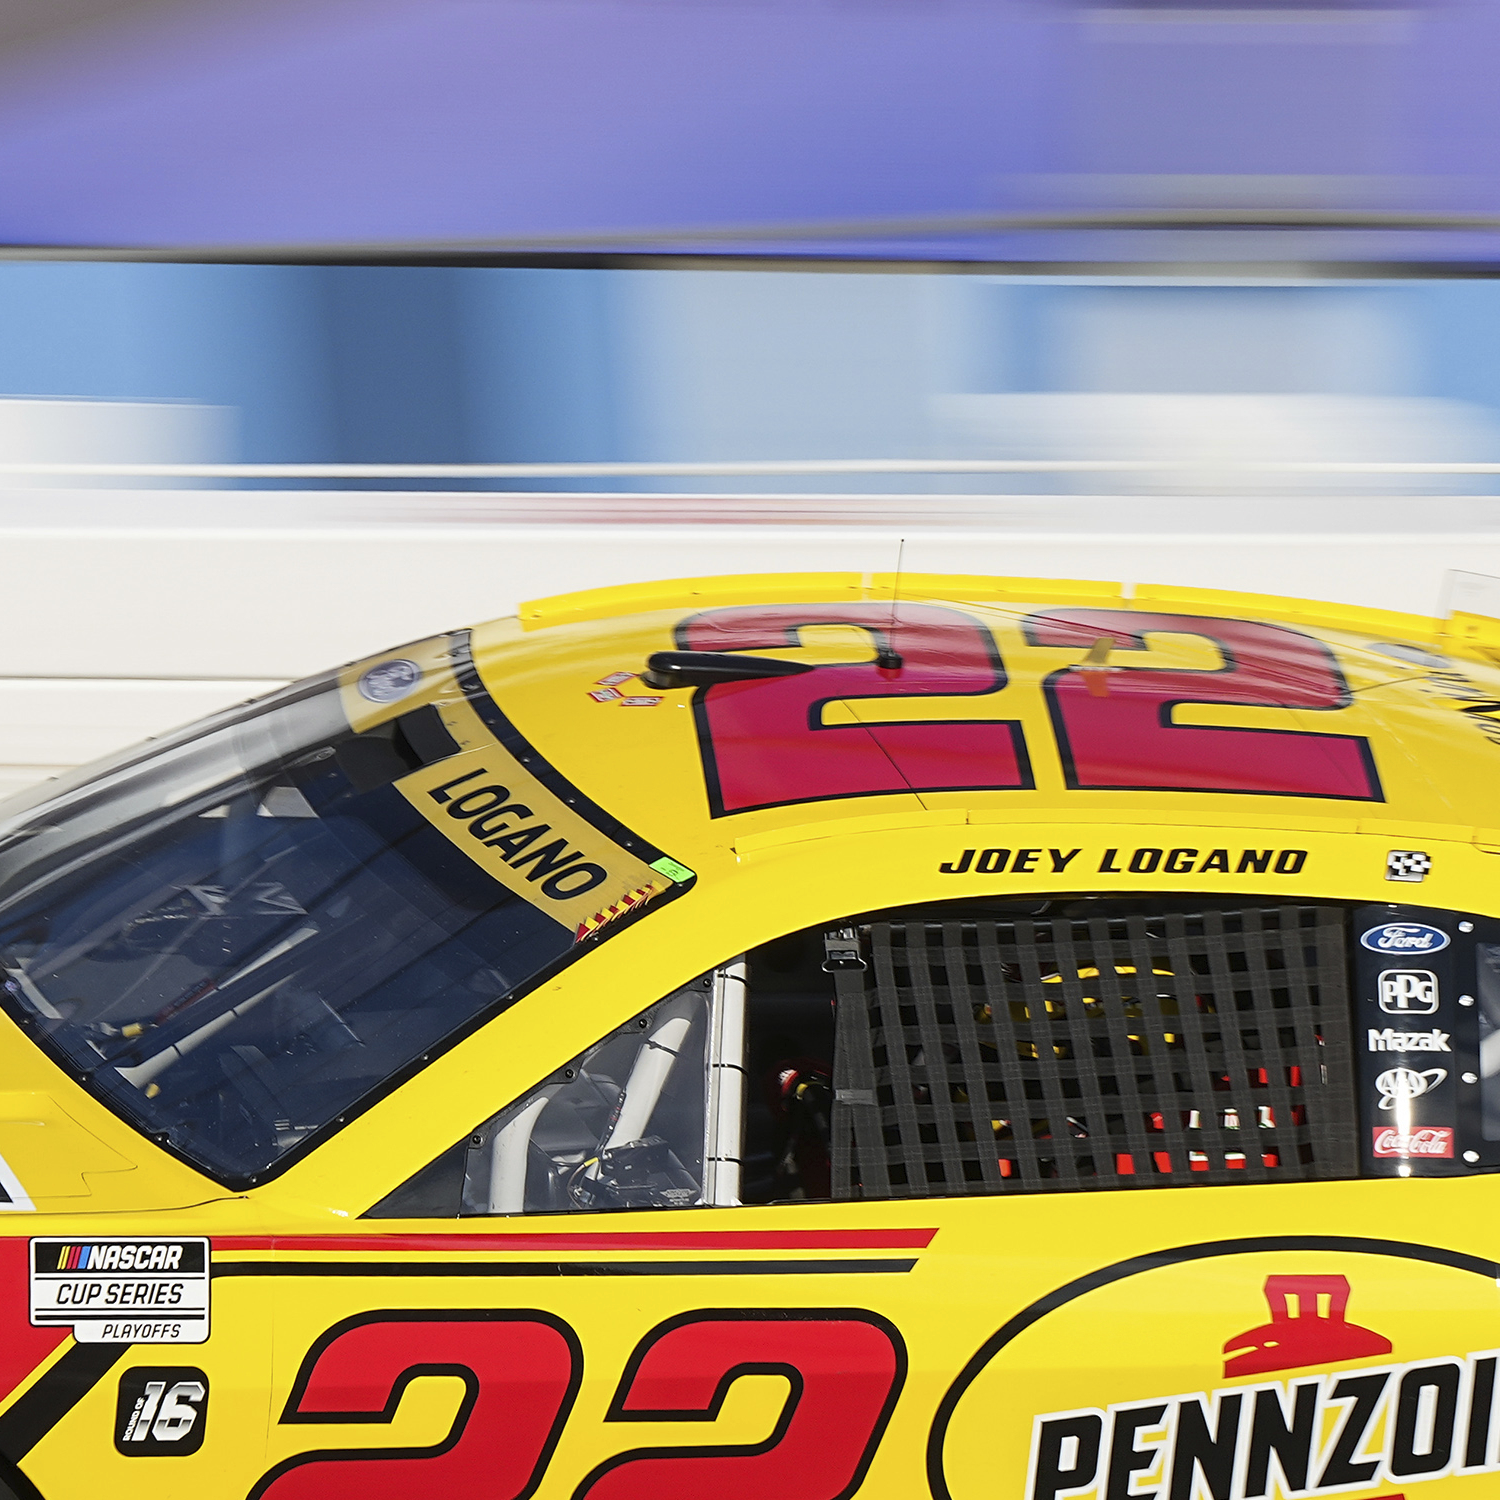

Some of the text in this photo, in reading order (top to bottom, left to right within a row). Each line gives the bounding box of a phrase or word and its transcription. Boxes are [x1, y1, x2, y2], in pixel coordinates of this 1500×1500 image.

[674, 602, 1386, 819] 22
[427, 767, 608, 901] LOGANO
[940, 848, 1308, 874] JOEY LOGANO
[1378, 926, 1433, 948] Ford
[1382, 974, 1433, 1008] PPG
[1368, 1028, 1452, 1052] Mazak
[86, 1245, 184, 1270] NASCAR
[56, 1283, 184, 1305] CUP SERIES
[101, 1324, 182, 1339] PLAYOFFS
[122, 1397, 145, 1441] ROUND OF
[130, 1381, 206, 1441] 16
